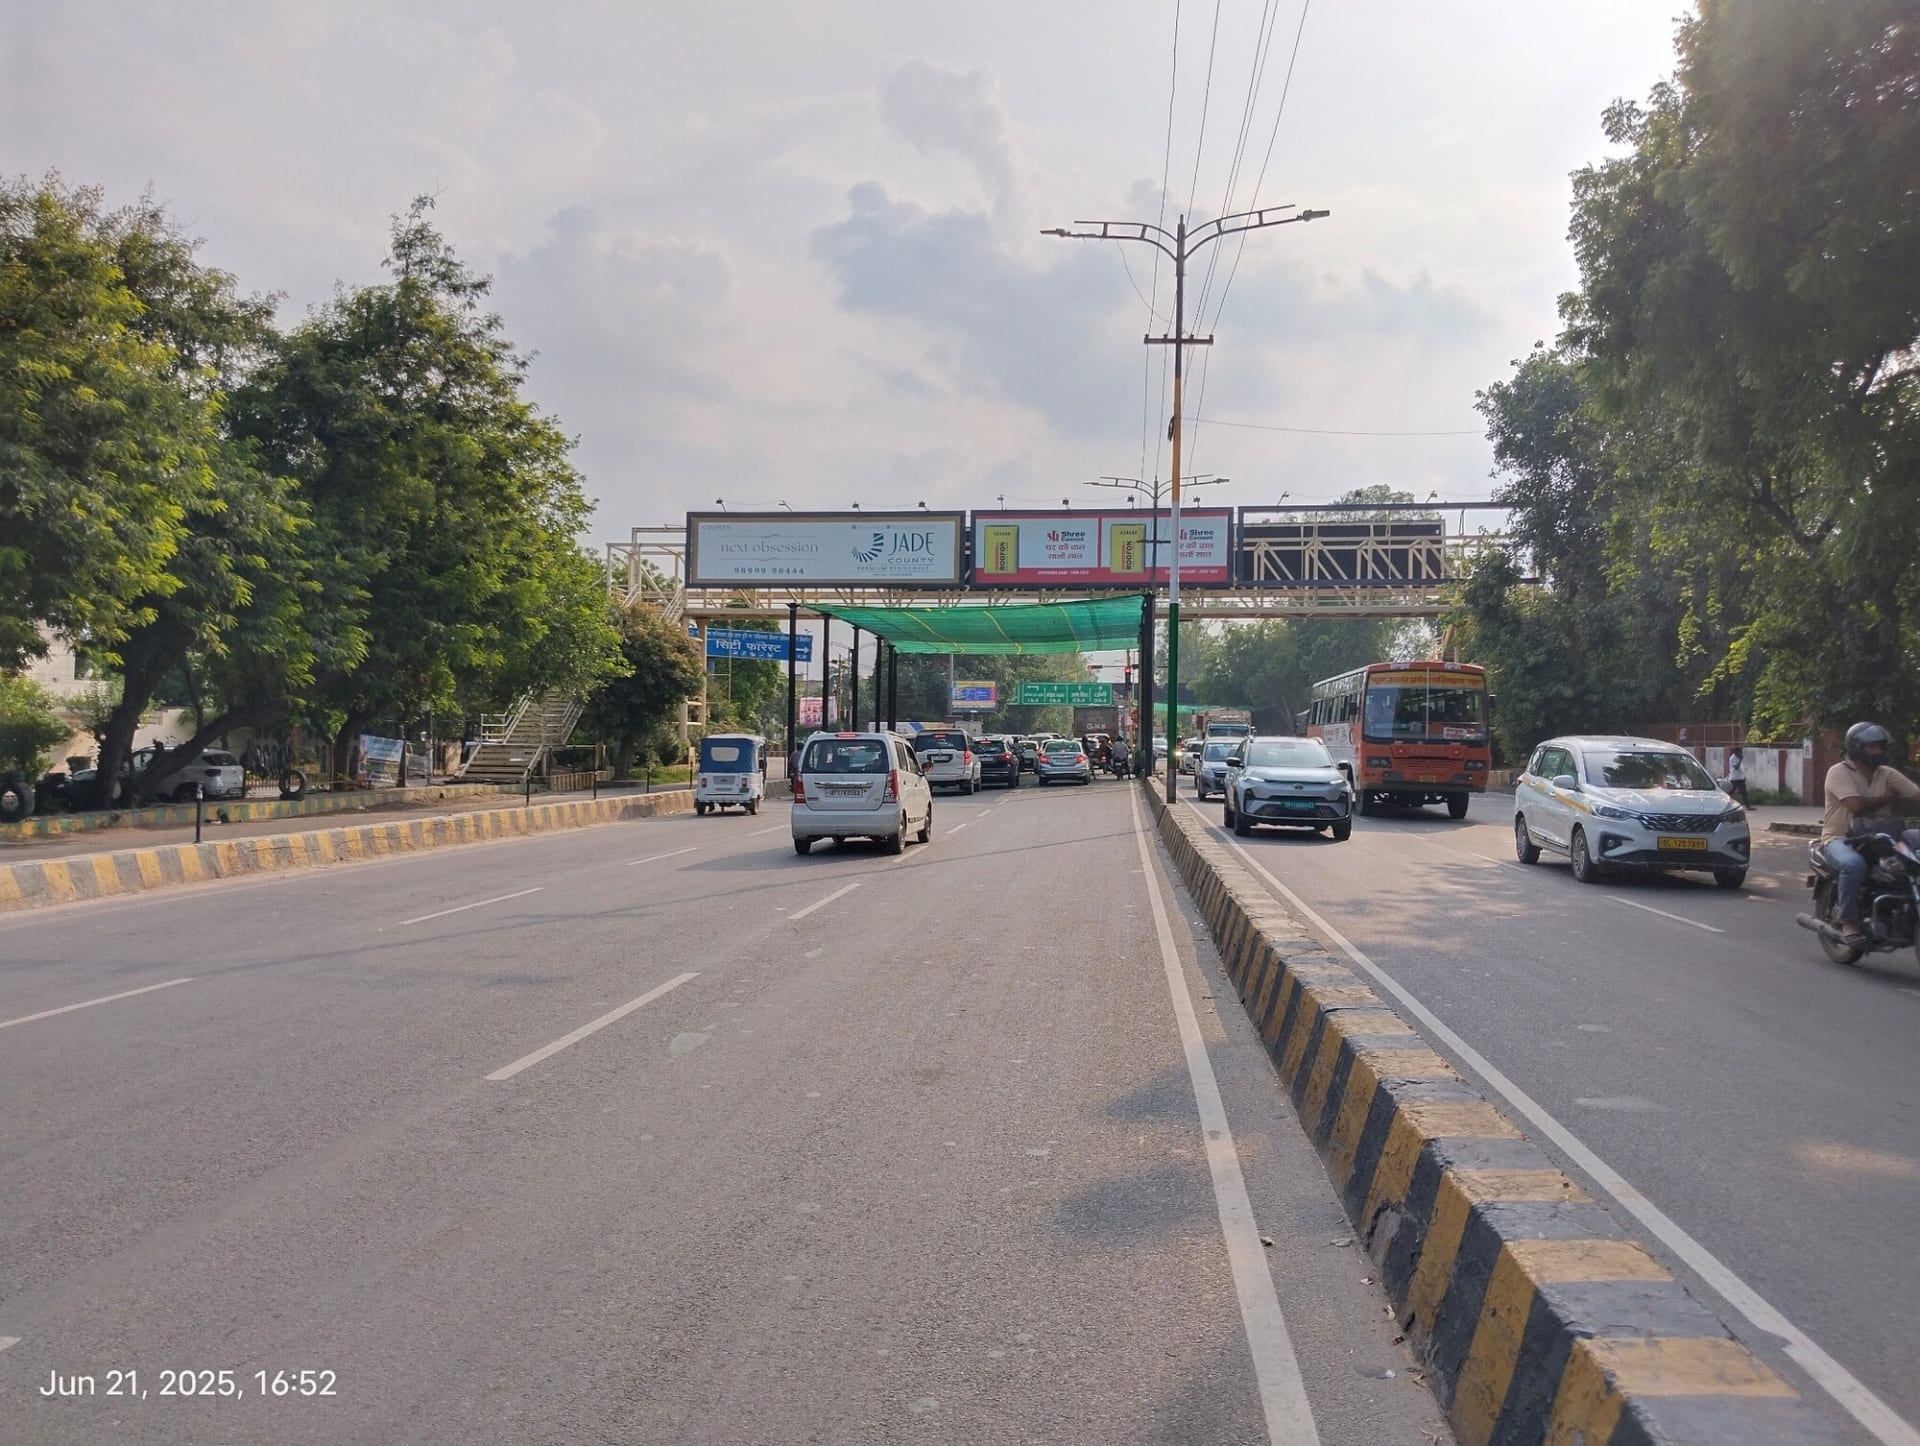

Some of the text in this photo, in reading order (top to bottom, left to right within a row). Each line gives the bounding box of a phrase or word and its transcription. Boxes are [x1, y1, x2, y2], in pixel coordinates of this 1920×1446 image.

[721, 540, 819, 553] next obsession
[887, 532, 936, 556] JADE
[734, 567, 805, 575] 98999 98444
[716, 639, 741, 651] सिटी
